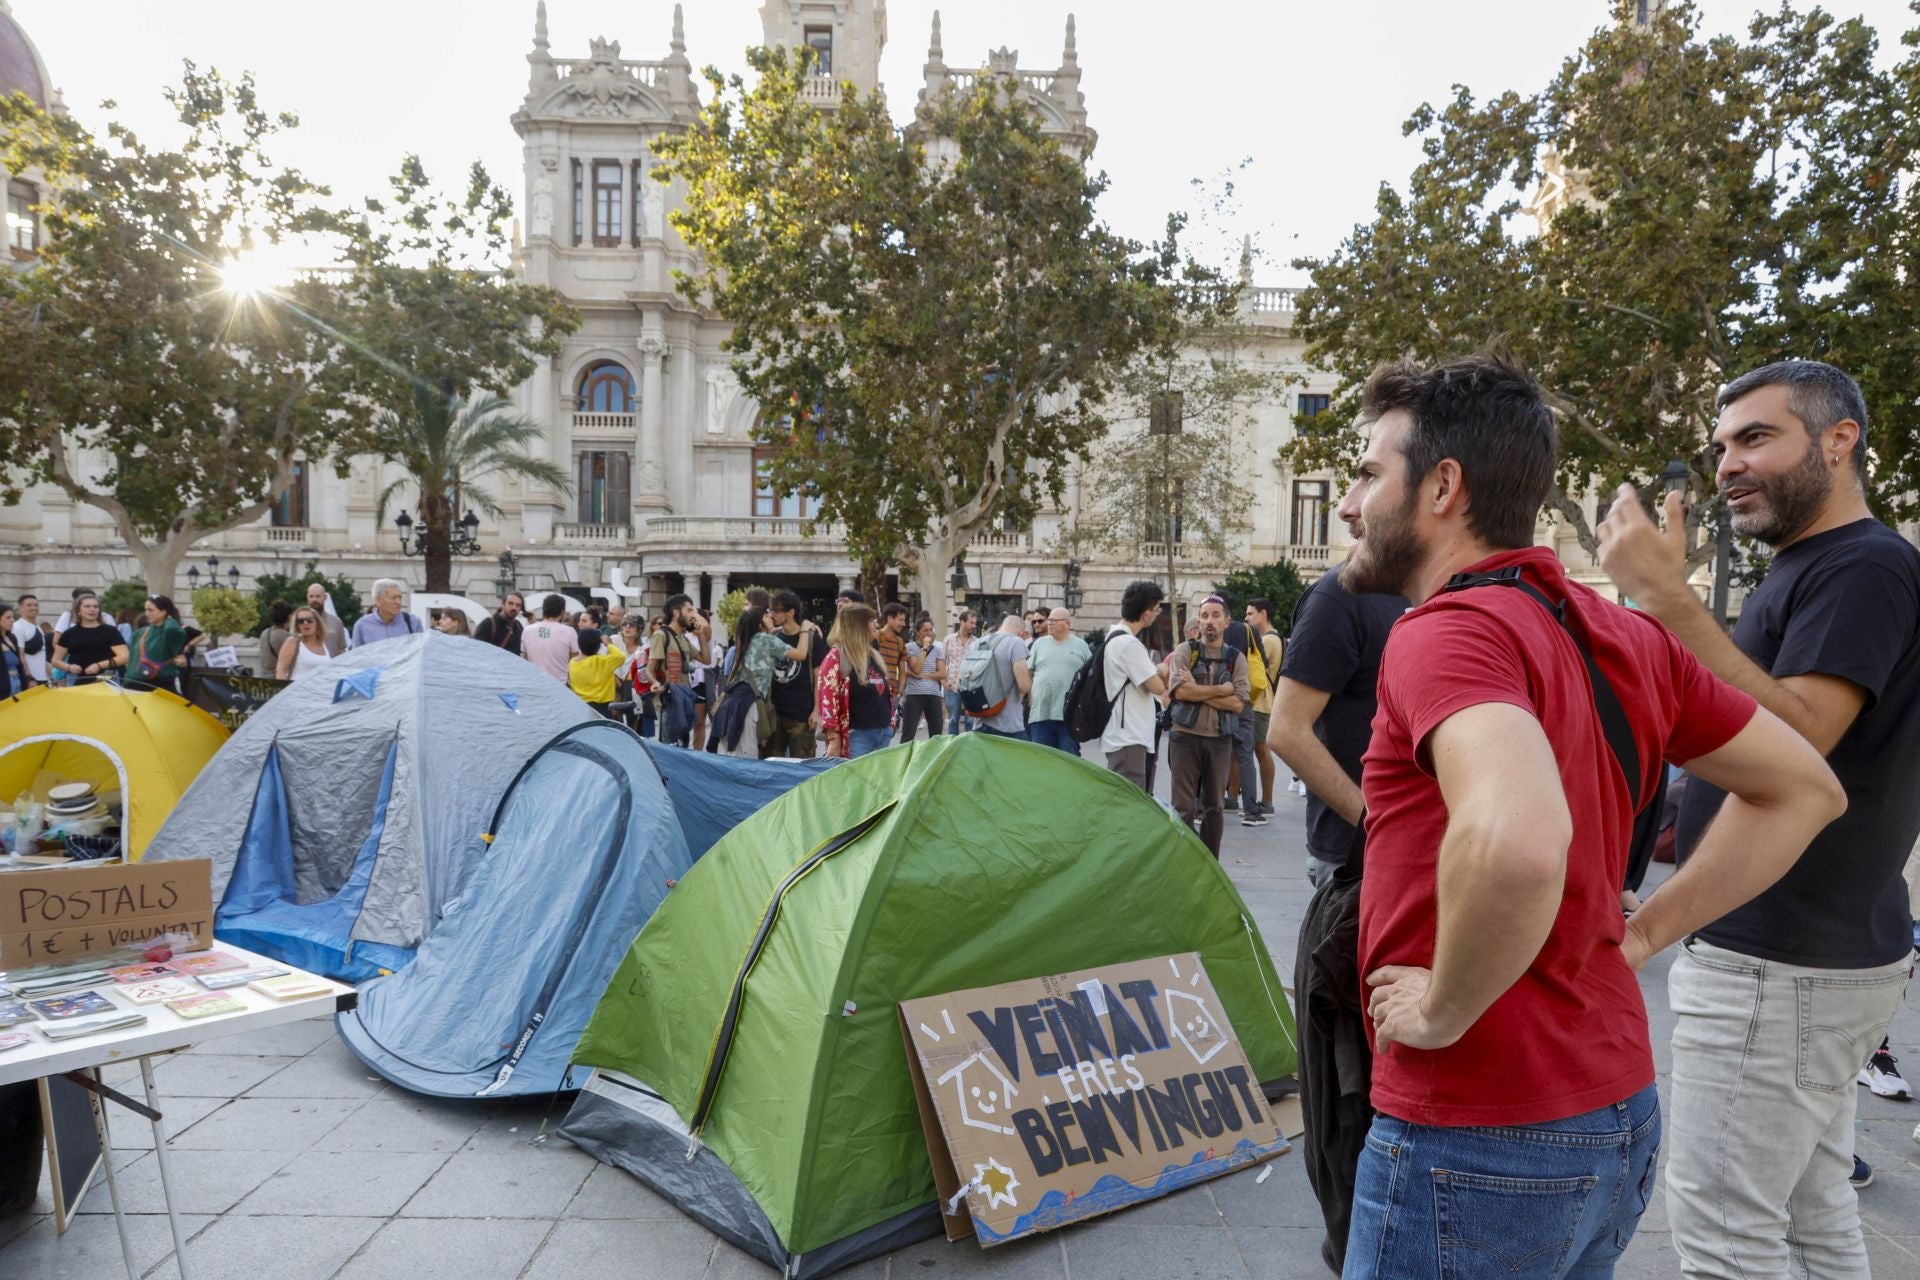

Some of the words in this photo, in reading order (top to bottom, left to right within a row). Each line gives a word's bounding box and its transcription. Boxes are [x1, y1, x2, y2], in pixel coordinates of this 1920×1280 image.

[19, 880, 178, 923] POSTALS
[513, 1027, 534, 1060] SECONDS
[1057, 1054, 1147, 1103] ERES
[1012, 1065, 1264, 1177] BENVINGUT
